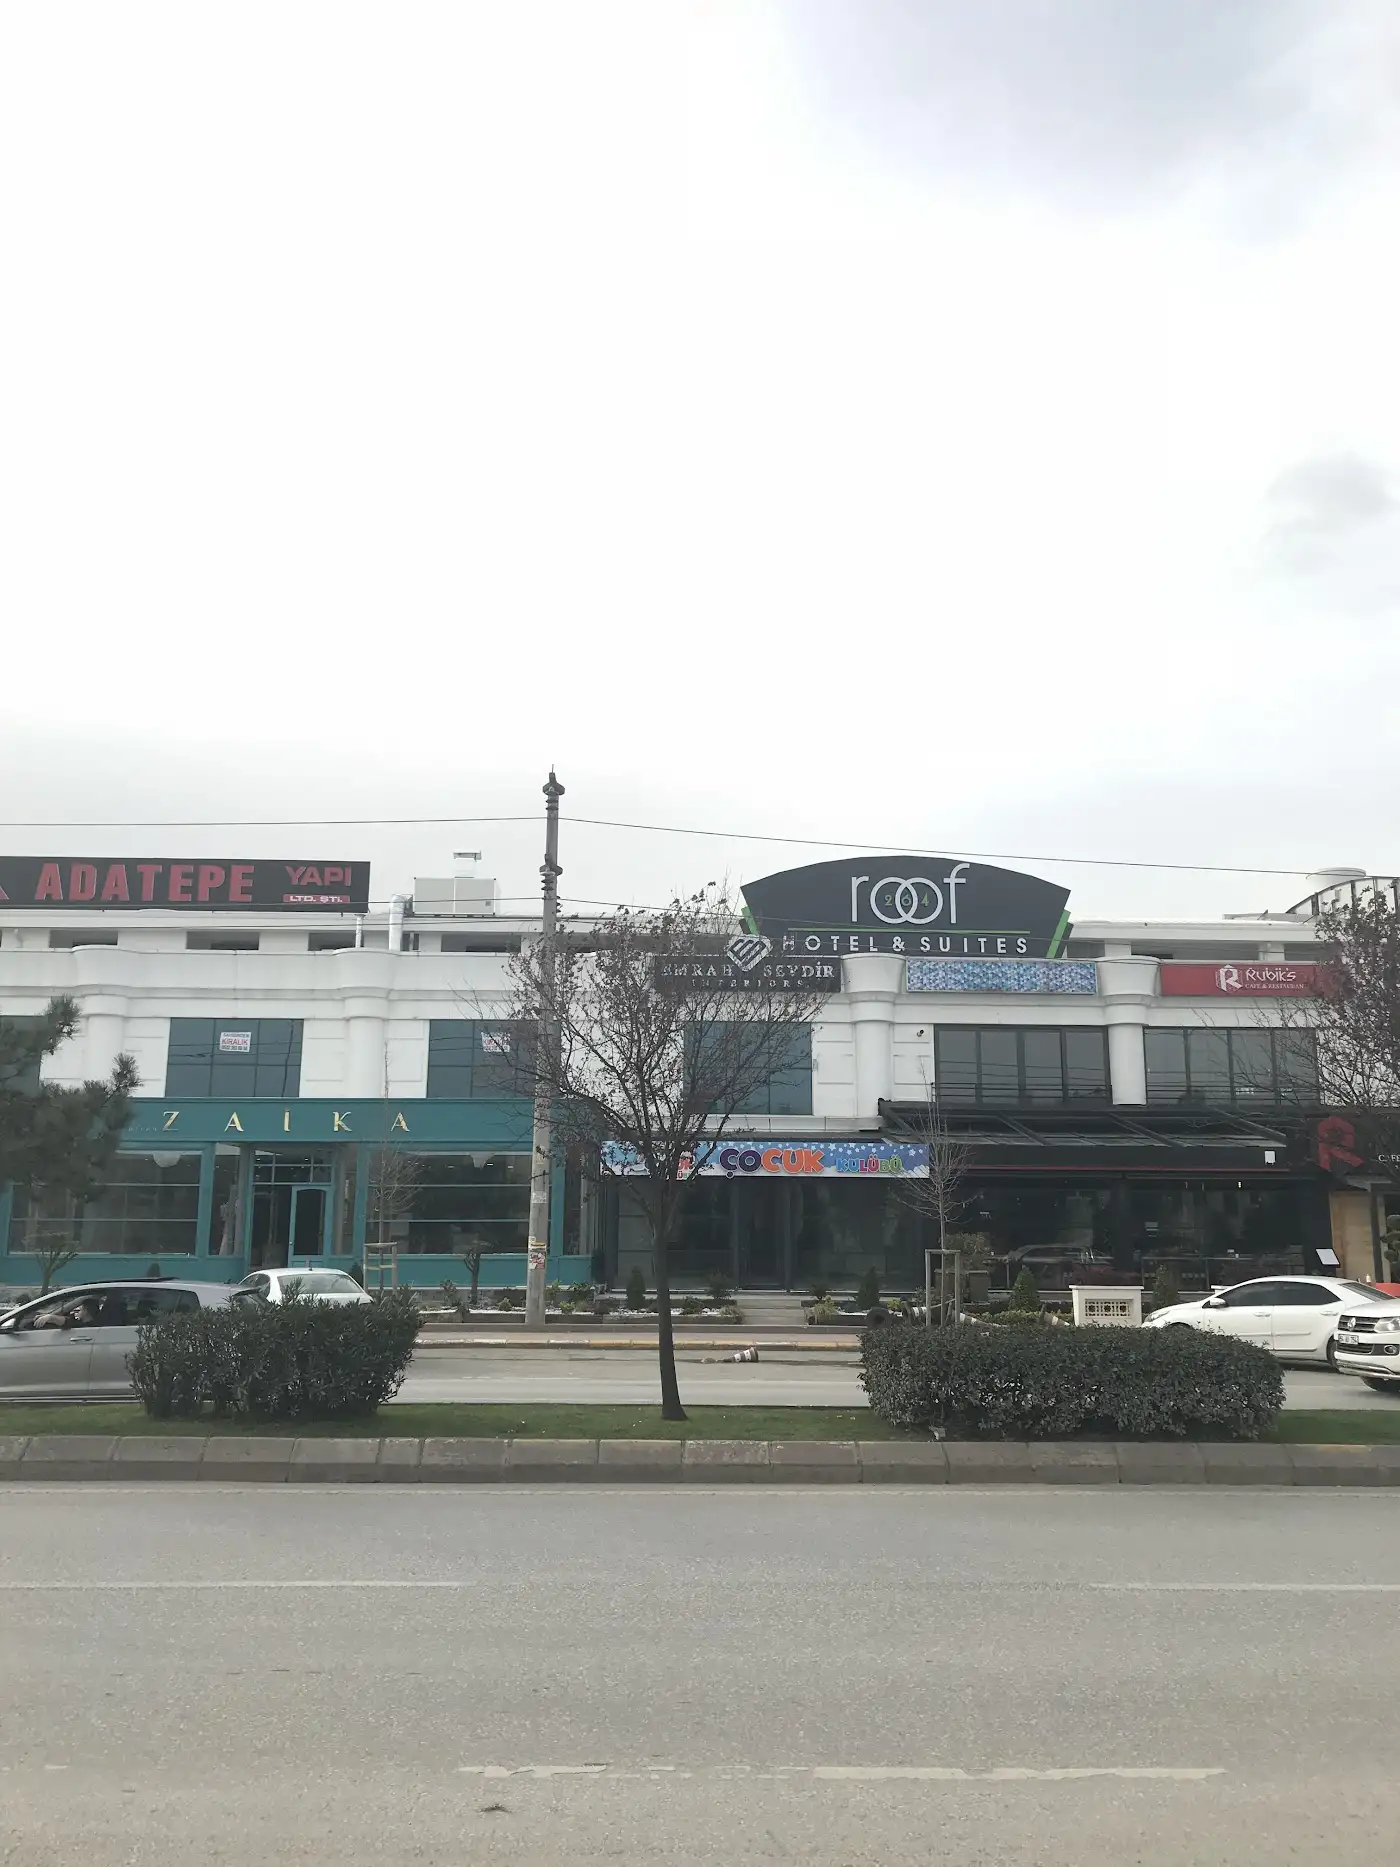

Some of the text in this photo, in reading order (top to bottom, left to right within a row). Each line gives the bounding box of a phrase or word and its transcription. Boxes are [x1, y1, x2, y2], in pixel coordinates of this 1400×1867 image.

[34, 862, 255, 902] ADATEPE
[285, 866, 352, 887] YAPI
[851, 862, 970, 925] roof
[884, 893, 930, 907] 264
[782, 935, 1028, 954] HOTEL & SUITES
[719, 1147, 826, 1179] ÇOCUK
[835, 1154, 903, 1173] KULÜBÜ
